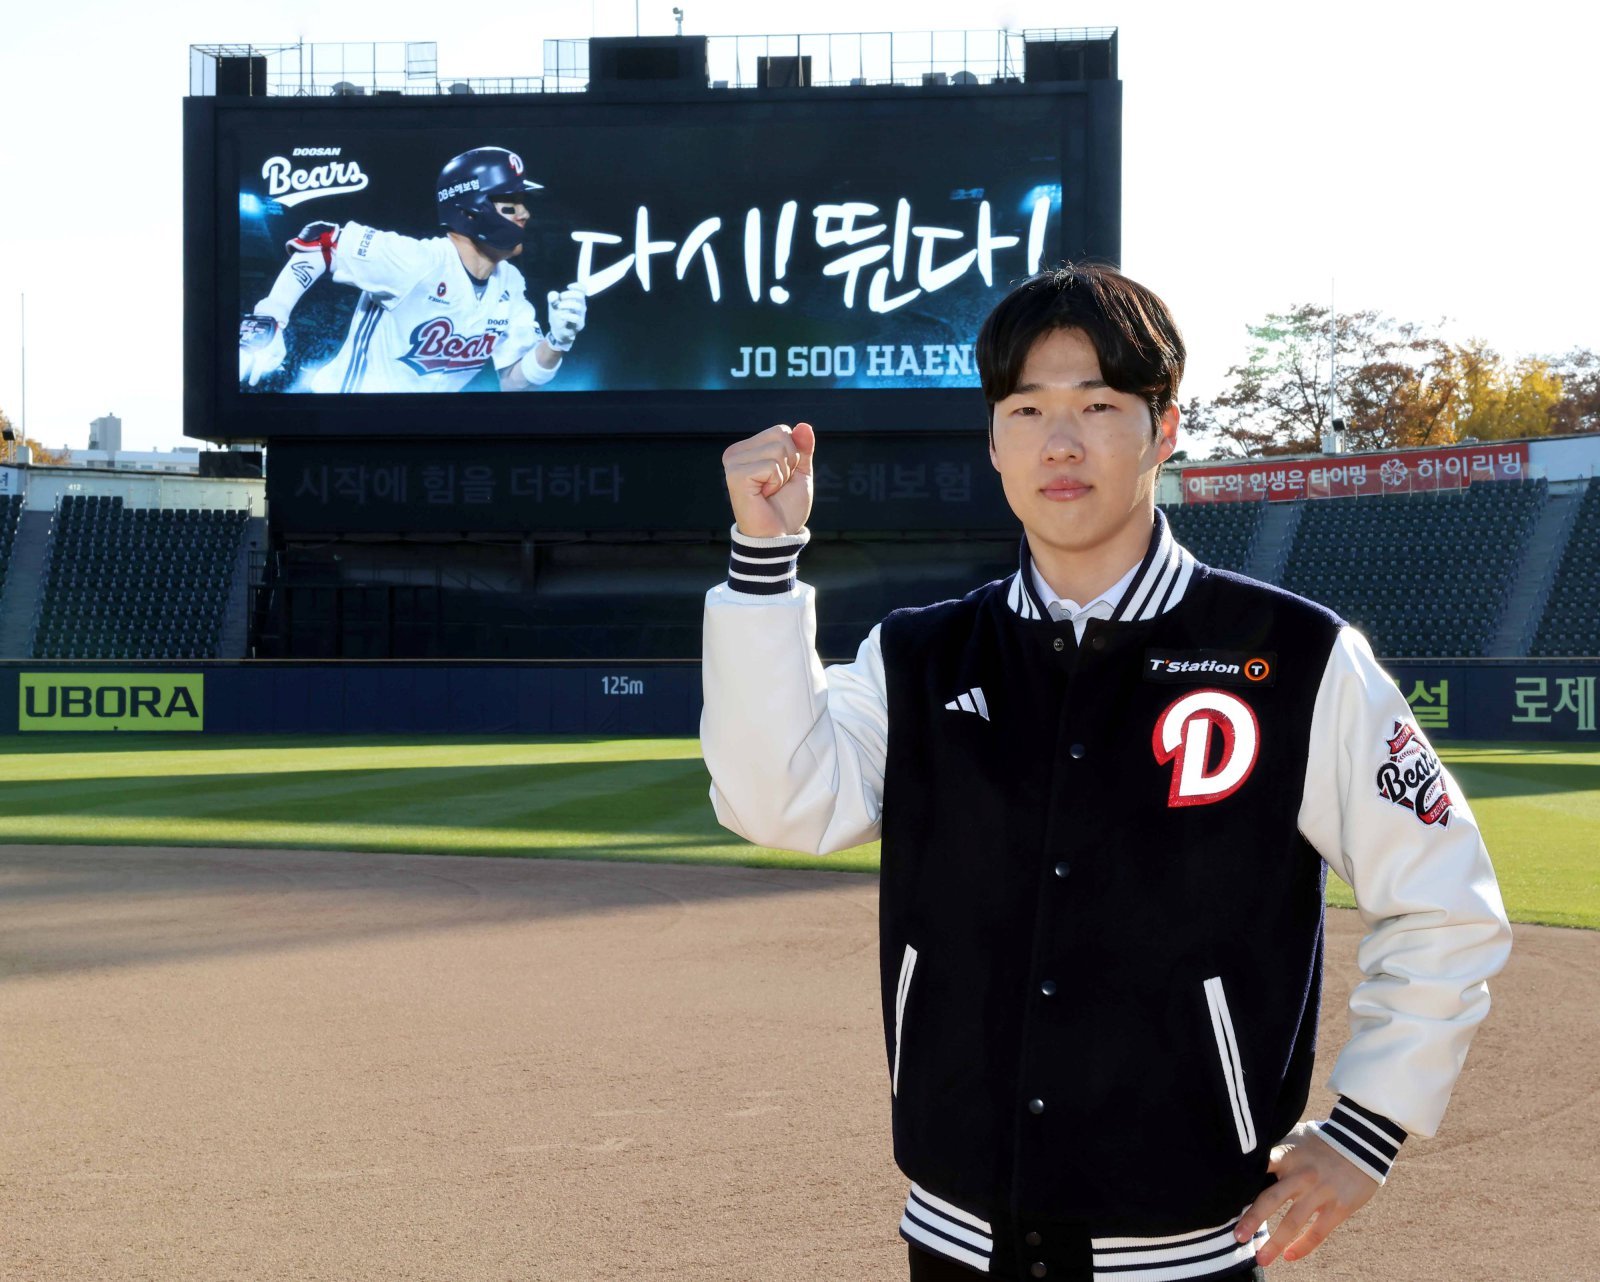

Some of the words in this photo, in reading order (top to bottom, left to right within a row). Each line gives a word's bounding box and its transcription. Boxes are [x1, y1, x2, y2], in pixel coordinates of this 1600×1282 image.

[292, 147, 341, 156] DOOSAN
[262, 156, 369, 207] Bears
[571, 200, 797, 304] 다시!
[812, 197, 1050, 313] 뛴다!
[487, 318, 509, 326] DOOS
[410, 317, 498, 370] Bear
[731, 347, 776, 377] JO
[787, 346, 855, 377] SOO
[866, 344, 979, 376] HAEN
[295, 465, 408, 504] 시작에
[422, 465, 497, 504] 힘을
[510, 464, 624, 503] 더하다
[813, 462, 972, 504] 손해보험
[1189, 474, 1243, 496] 야구와
[1250, 470, 1305, 493] 인생은
[1311, 464, 1366, 487] 타이밍
[1417, 452, 1521, 478] 하이리빙
[602, 676, 643, 695] 125m
[1150, 659, 1240, 675] T'Station
[25, 686, 199, 718] UBORA
[1395, 680, 1449, 728] 설
[1512, 676, 1597, 731] 로제
[1152, 688, 1260, 808] D
